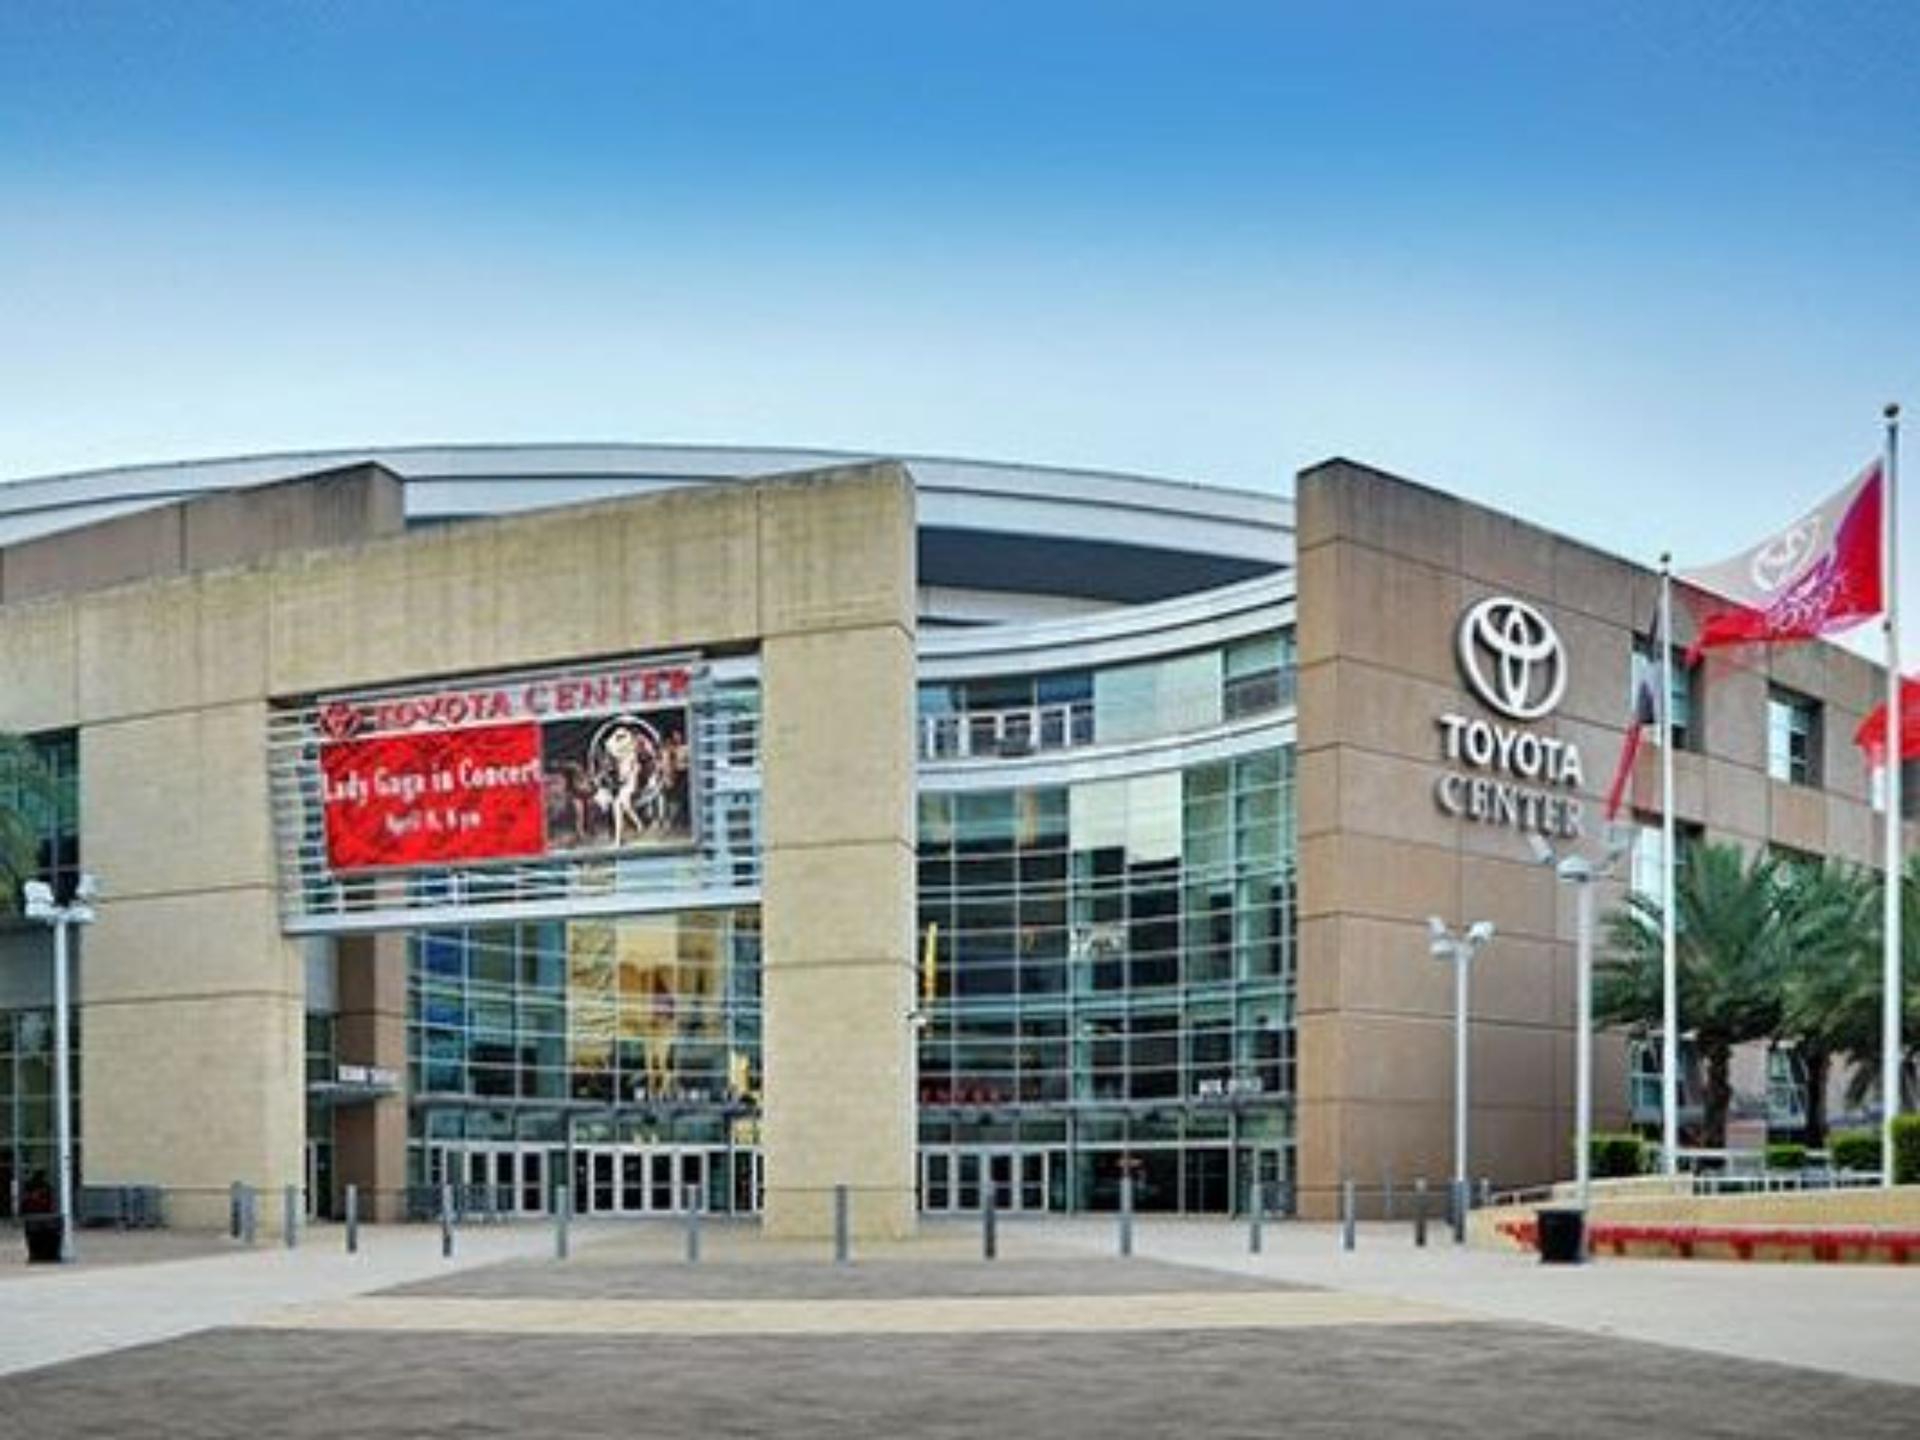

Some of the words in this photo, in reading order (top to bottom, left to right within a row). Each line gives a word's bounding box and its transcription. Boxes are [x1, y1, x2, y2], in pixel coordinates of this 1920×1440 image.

[374, 690, 511, 730] TOYOTA
[521, 668, 692, 715] CENTER
[1437, 713, 1583, 786] TOYOTA
[322, 769, 369, 808] Lady
[374, 766, 426, 805] Gaga
[431, 762, 455, 793] in
[459, 757, 542, 789] Concert
[1437, 773, 1583, 838] CENTER
